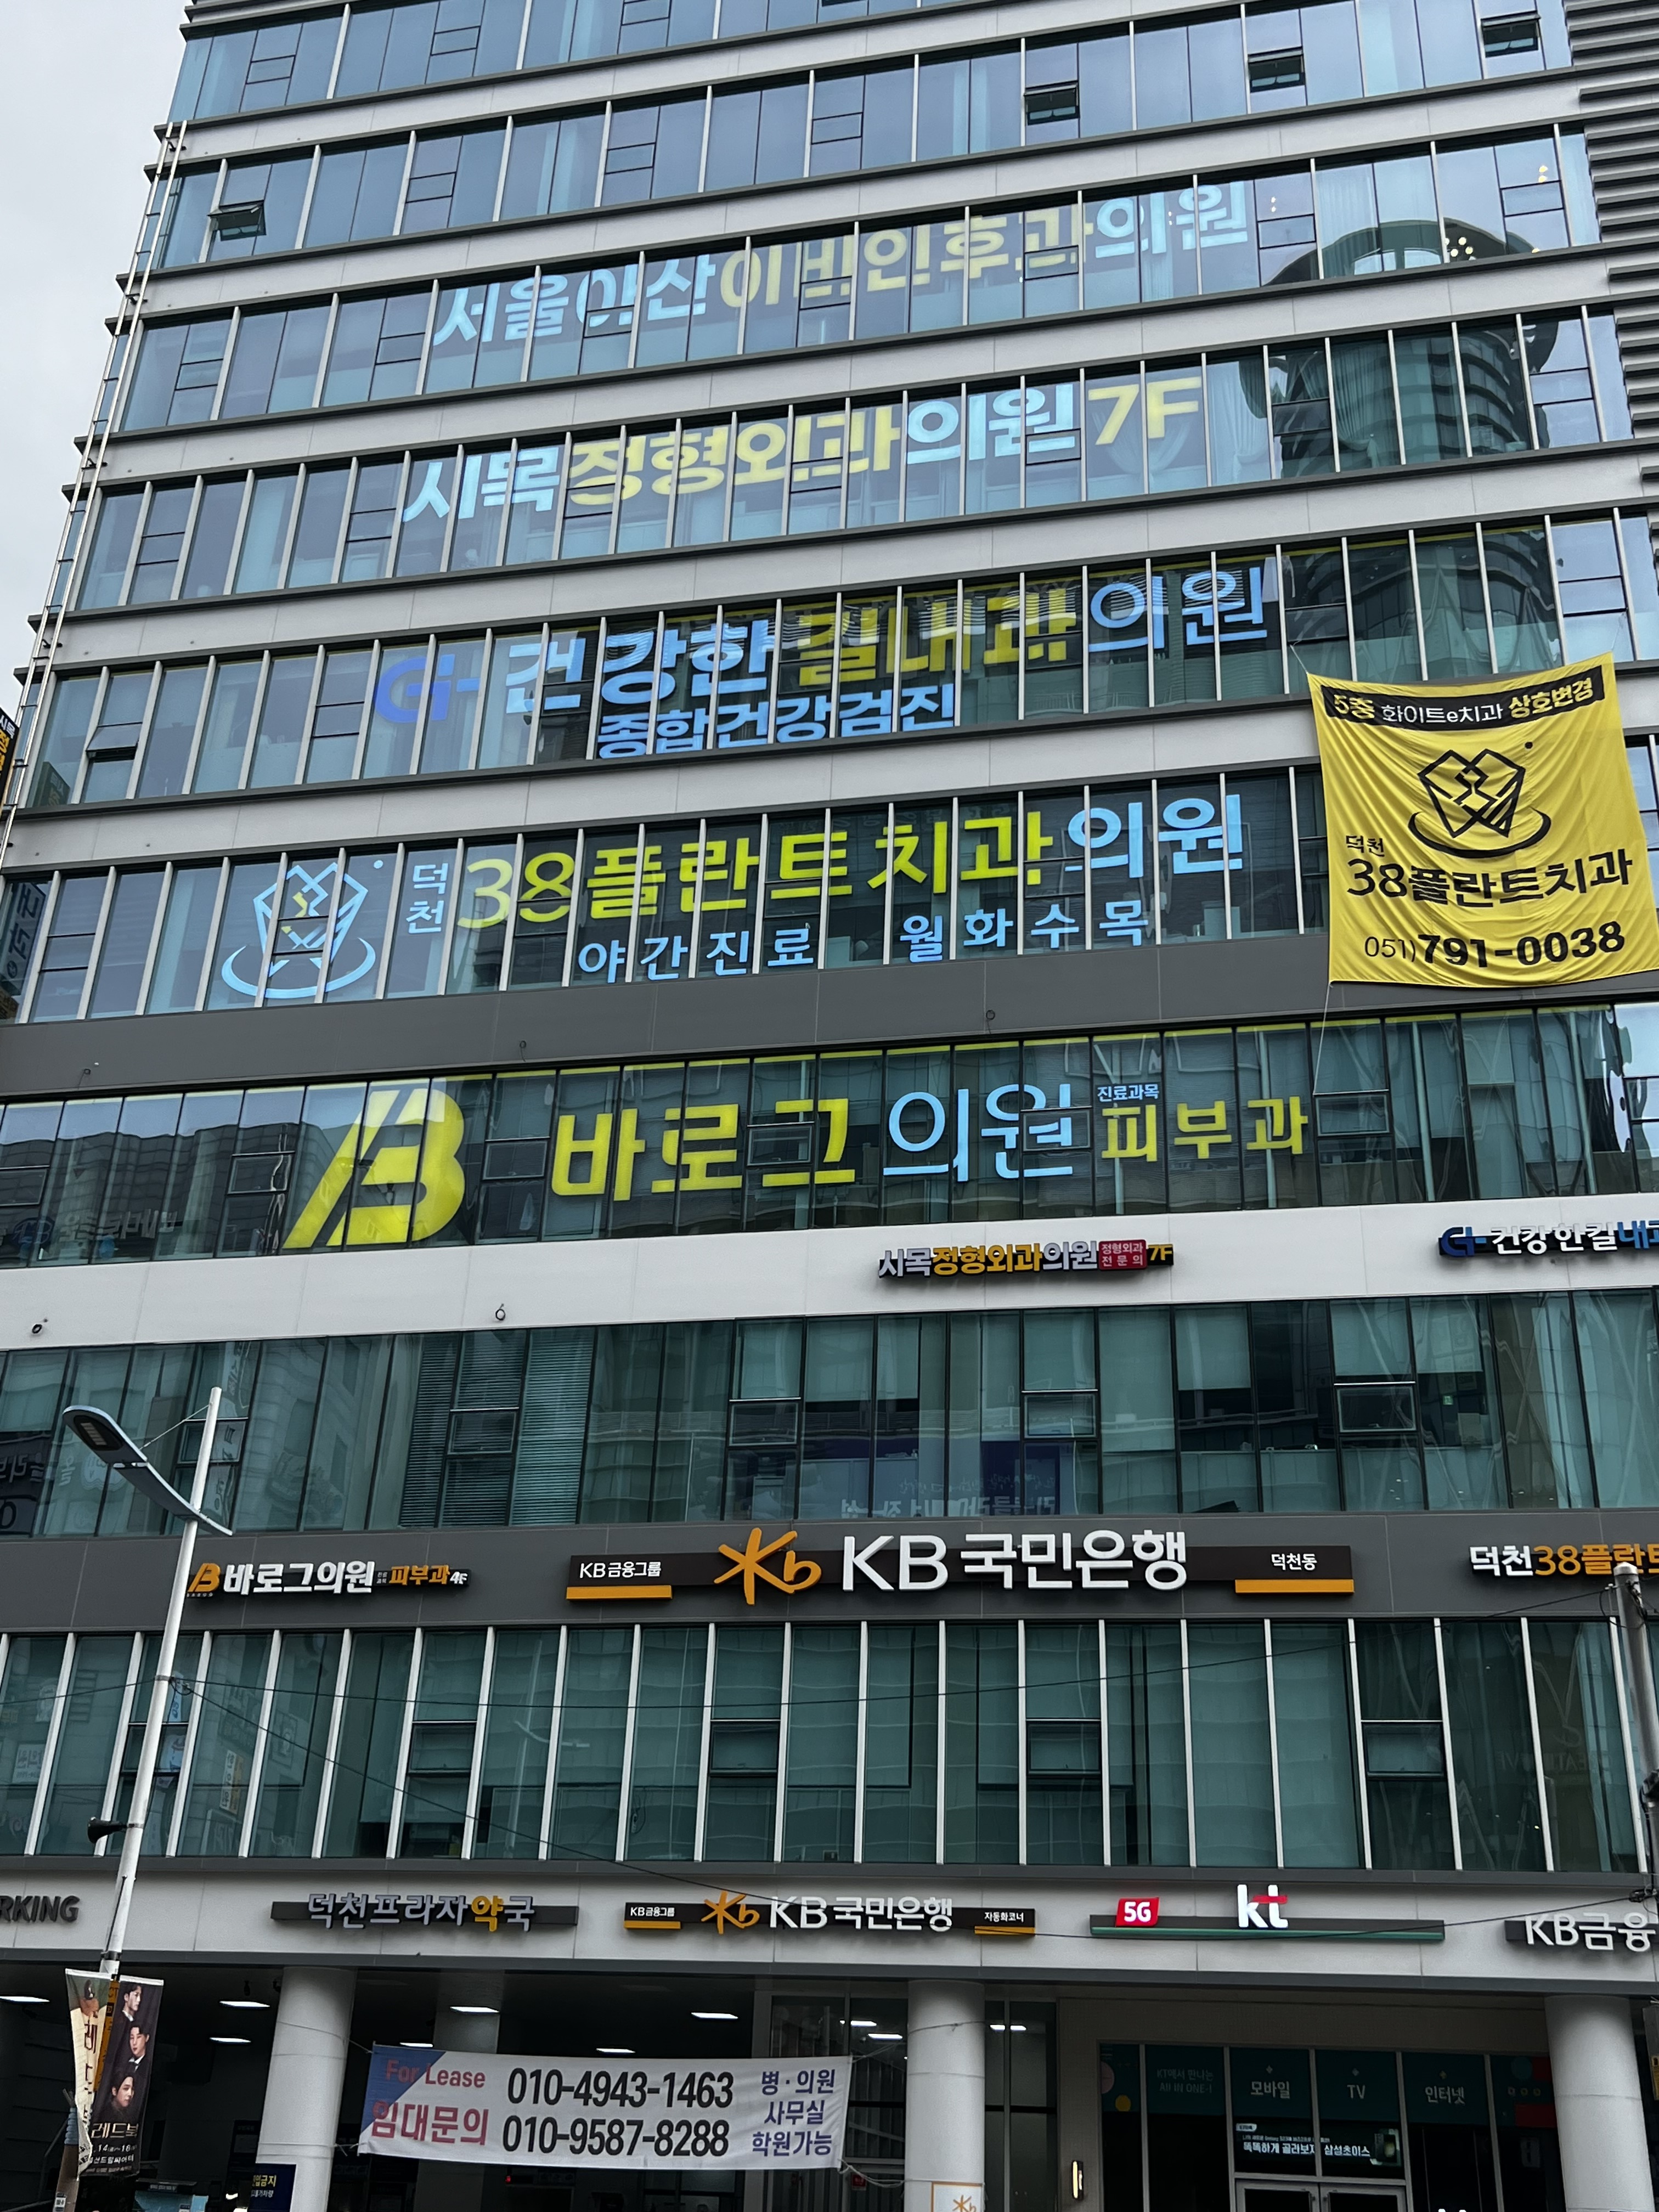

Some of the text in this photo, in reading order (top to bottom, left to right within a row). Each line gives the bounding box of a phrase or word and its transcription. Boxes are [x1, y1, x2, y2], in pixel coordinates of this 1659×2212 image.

[1088, 376, 1201, 446] 7F
[1334, 678, 1594, 724] 5층 화이트e치과 상호변경
[1346, 835, 1385, 857] 덕천
[1346, 849, 1633, 908] 38플란트치과
[1098, 1084, 1160, 1103] 진료과목
[1101, 1096, 1308, 1162] 피부과
[1101, 1242, 1143, 1255] 정형외과
[1148, 1244, 1173, 1261] 7F
[843, 1528, 1187, 1591] KB국민은행
[1271, 1553, 1317, 1571] 덕천동
[223, 1561, 375, 1595] 바로그의원
[388, 1565, 468, 1585] 피부과 4F
[308, 1892, 535, 1932] 덕천프라자약국
[769, 1895, 953, 1932] KB국민은행
[984, 1911, 1025, 1923] 자동화코너
[1123, 1901, 1152, 1922] 5G
[1237, 1884, 1288, 1928] kt
[1525, 1912, 1656, 1952] KB금융
[385, 2059, 486, 2088] For Lease
[507, 2067, 734, 2108] 010-4943-1463
[1250, 2080, 1290, 2099] 모바일
[1347, 2084, 1366, 2100] TV
[1424, 2085, 1466, 2106] 인터넷
[371, 2100, 489, 2146] 임대문의
[764, 2100, 825, 2126] 사무실
[503, 2115, 730, 2156] 010-9587-8288
[752, 2131, 832, 2157] 학원가능
[1324, 2144, 1371, 2157] 삼성초이스
